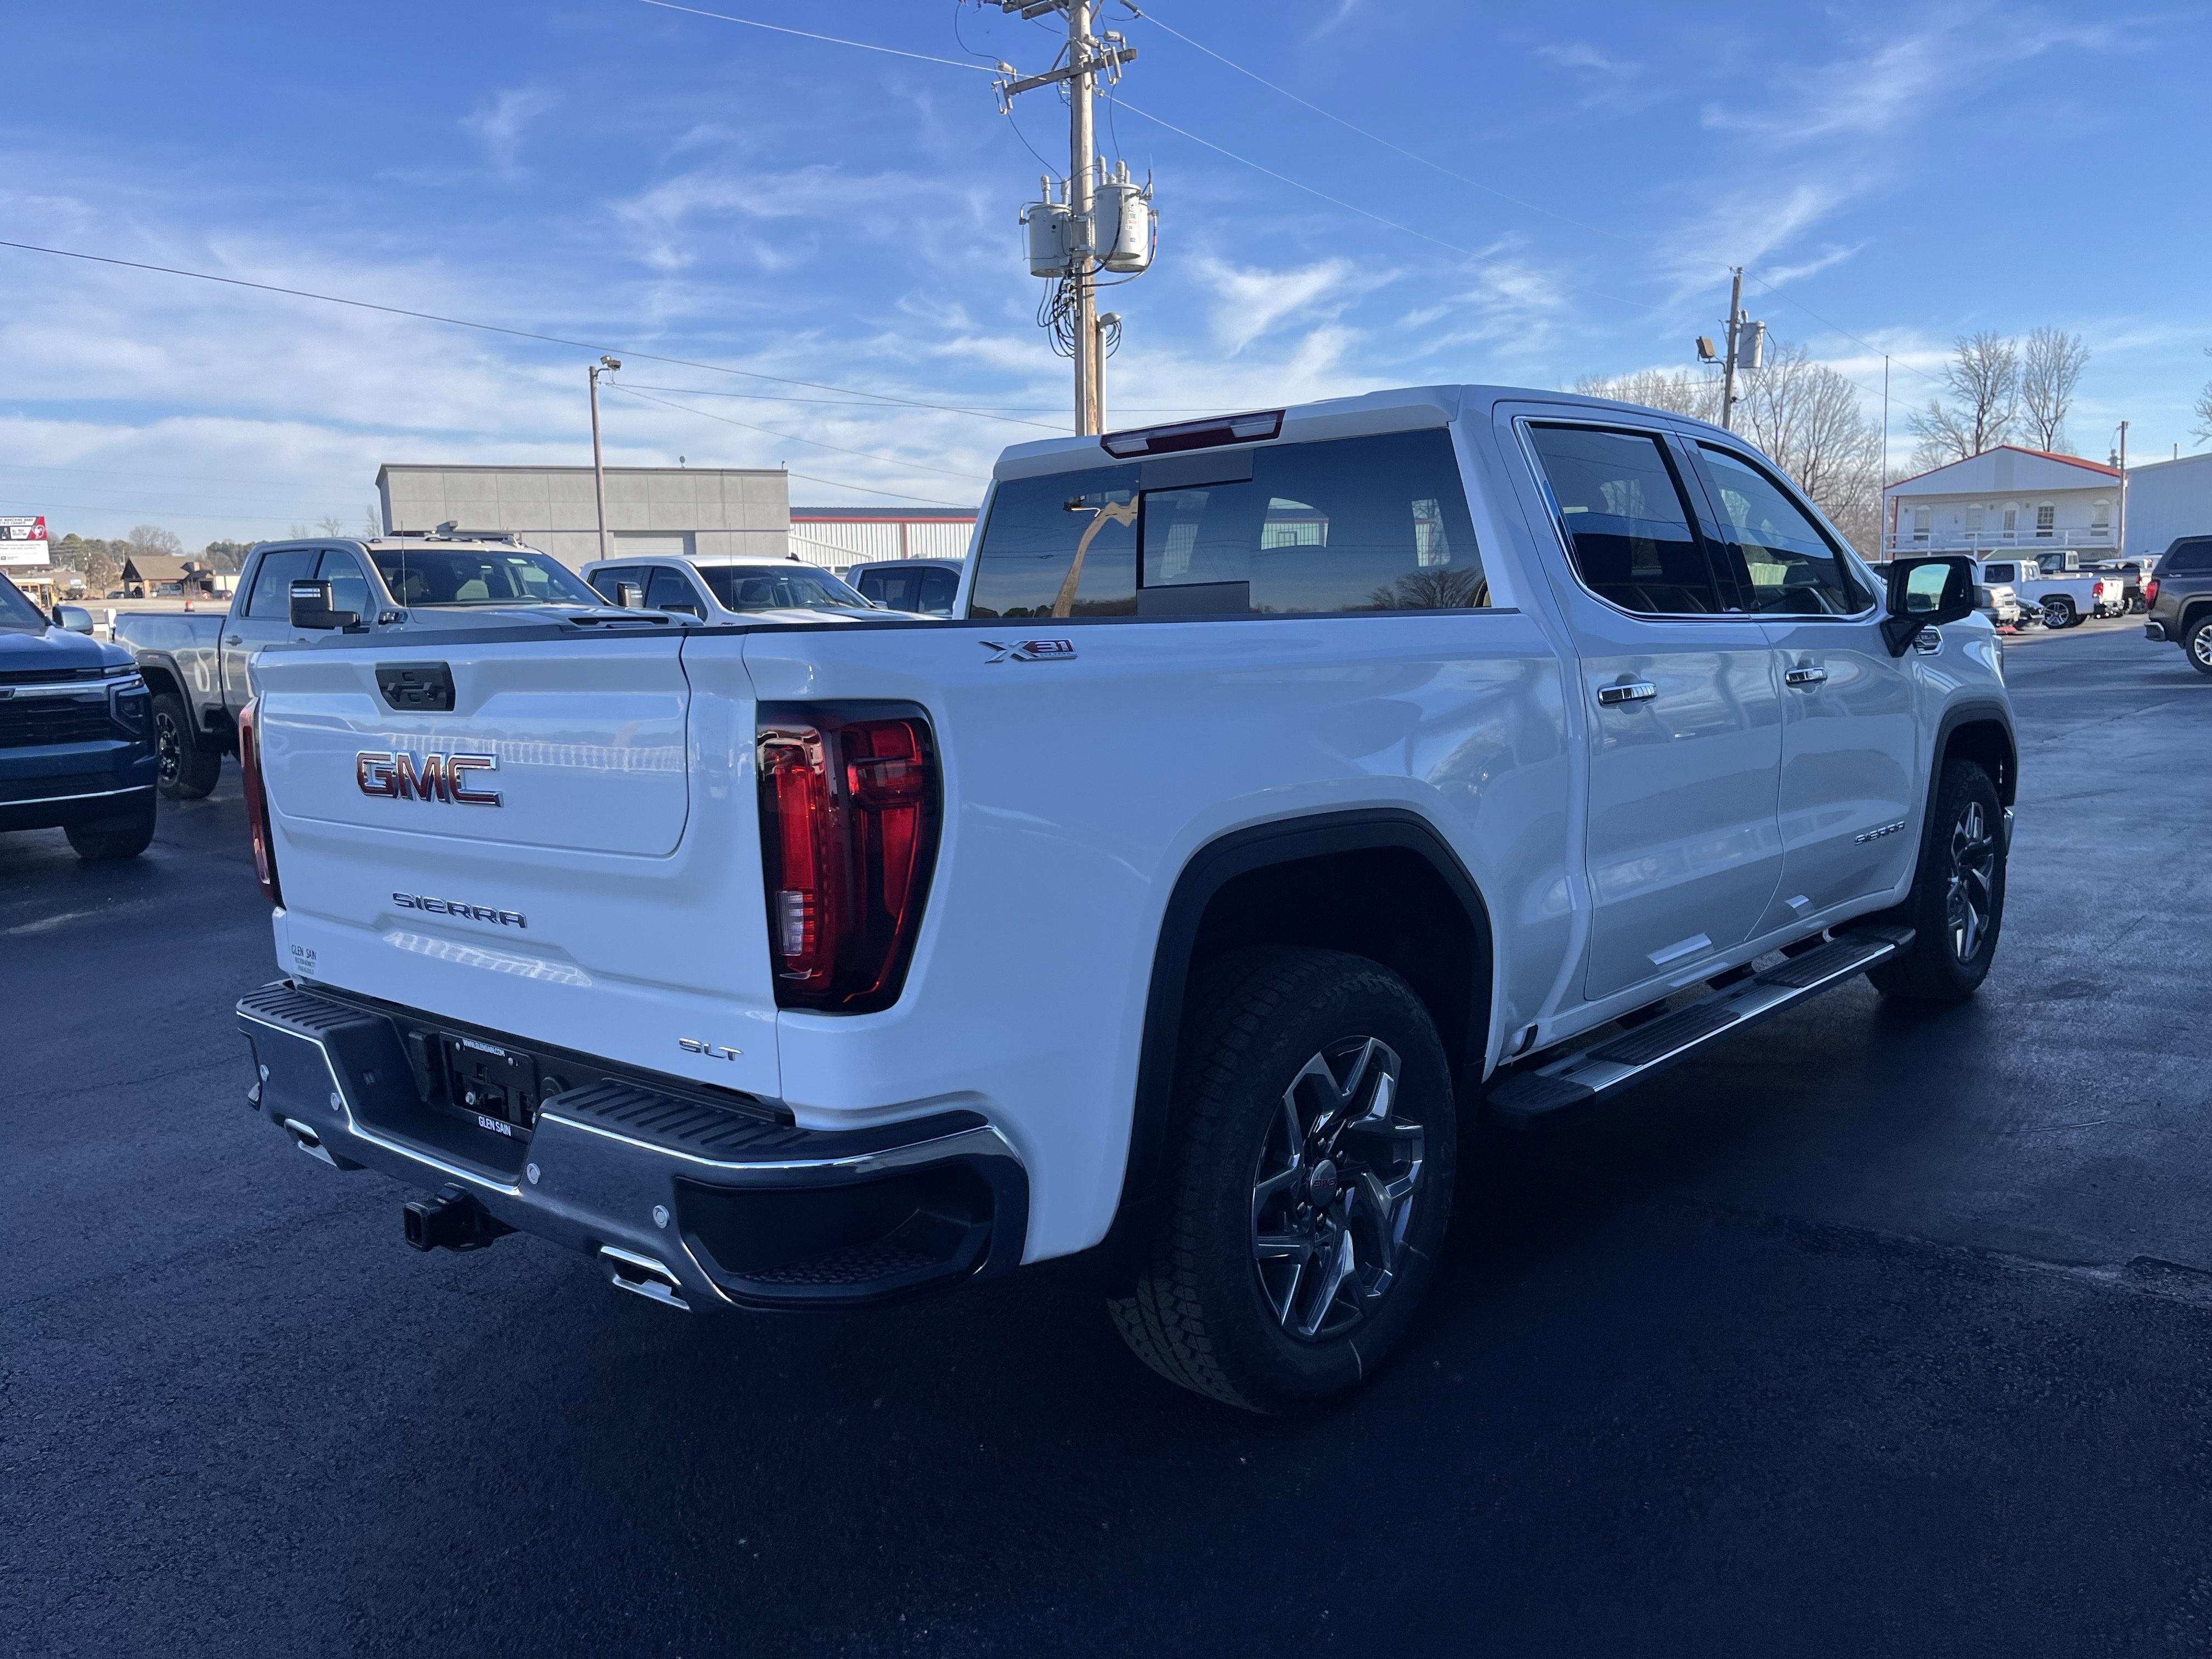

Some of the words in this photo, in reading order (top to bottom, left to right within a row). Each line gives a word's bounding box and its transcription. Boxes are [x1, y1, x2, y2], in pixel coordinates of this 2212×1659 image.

[356, 750, 504, 807] GMC
[1855, 821, 1905, 845] SIERRA
[392, 891, 527, 928] SIERRA
[291, 944, 303, 956] GLEN
[306, 949, 317, 960] SAIN
[679, 1038, 743, 1061] SLT
[478, 1116, 495, 1131] GLEN
[495, 1121, 511, 1136] SAIN
